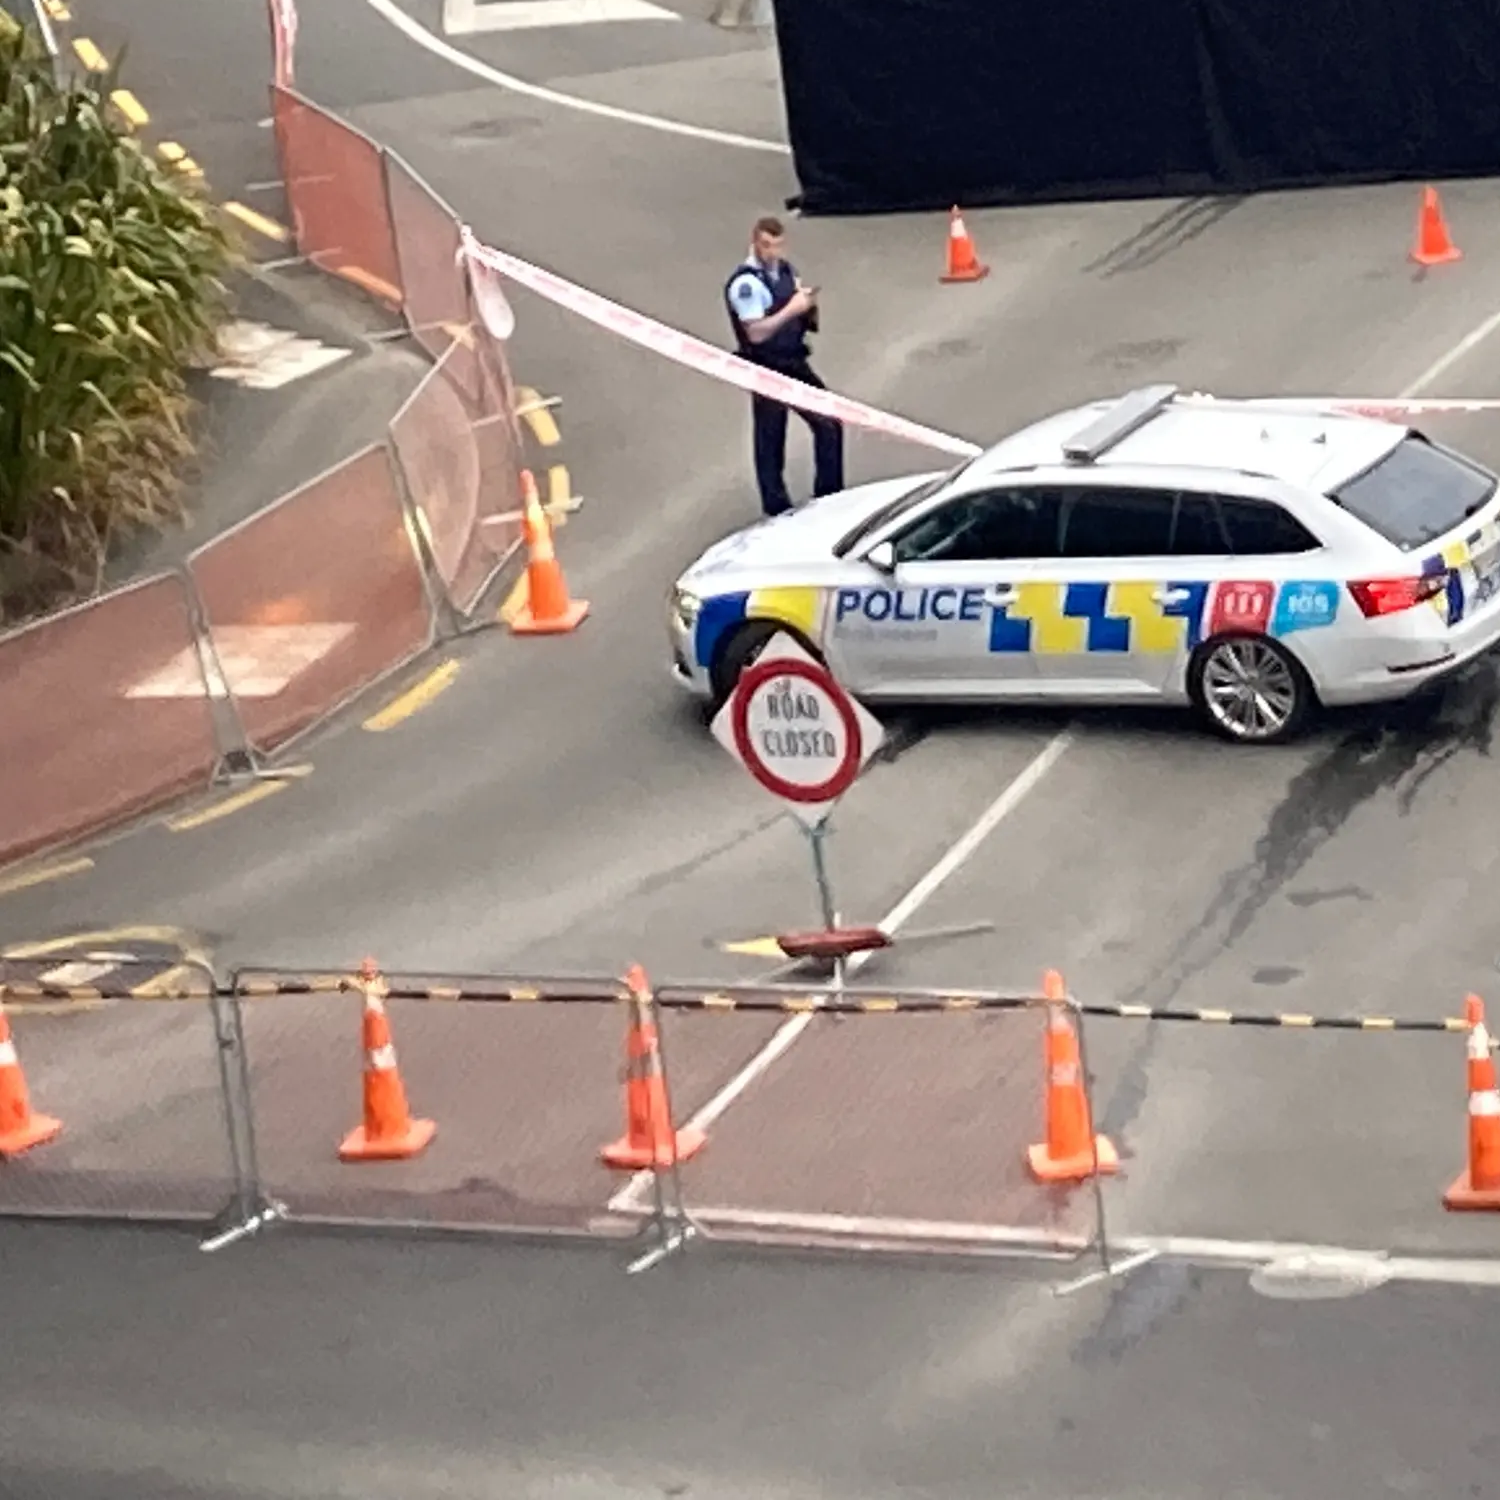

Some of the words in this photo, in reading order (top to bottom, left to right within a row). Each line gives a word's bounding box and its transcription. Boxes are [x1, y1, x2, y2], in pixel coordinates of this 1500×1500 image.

[836, 588, 985, 622] POLICE
[765, 693, 820, 719] ROAD
[762, 729, 837, 757] CLOSED
